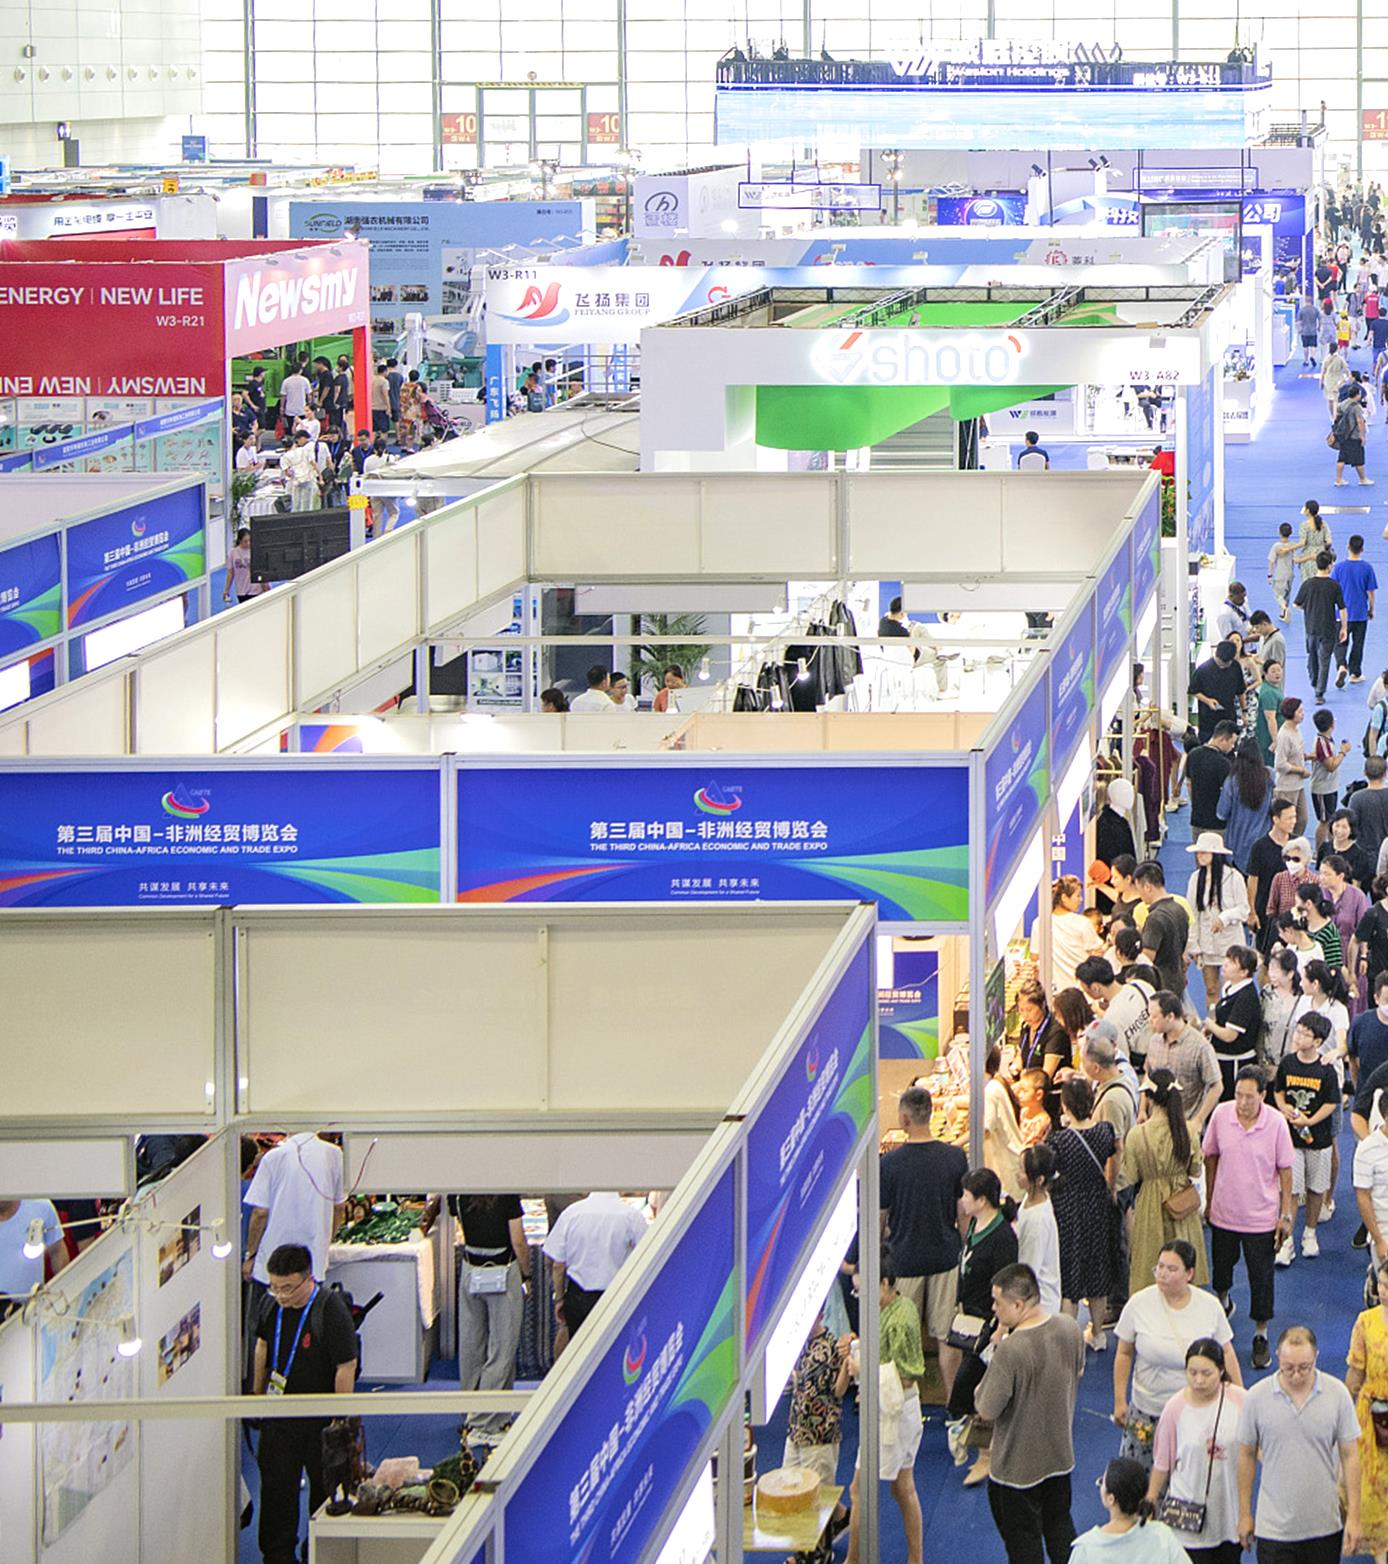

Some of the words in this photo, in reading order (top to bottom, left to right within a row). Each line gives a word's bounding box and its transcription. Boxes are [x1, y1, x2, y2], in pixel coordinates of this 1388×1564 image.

[488, 269, 538, 281] W3-R11
[101, 286, 153, 306] NEW
[158, 286, 204, 306] LIFE
[234, 267, 358, 331] Newsmy
[156, 315, 205, 327] W3-R21
[57, 823, 298, 843] 第三届中国-非洲经贸博览会
[590, 820, 828, 840] 第三届中国-非洲经贸博览会
[57, 845, 74, 854] THE
[77, 845, 104, 854] THIRD
[105, 845, 169, 854] CHINA-AFRICA
[170, 845, 219, 854] ECONOMIC
[219, 845, 240, 854] AND
[240, 845, 271, 854] TRADE
[272, 845, 298, 854] EXPO
[590, 842, 608, 851] THE
[609, 842, 637, 851] THIRD
[637, 842, 701, 851] CHINA-AFRICA
[702, 842, 750, 851] ECONOMIC
[750, 842, 770, 851] AND
[771, 842, 802, 851] TRADE
[803, 842, 828, 851] EXPO
